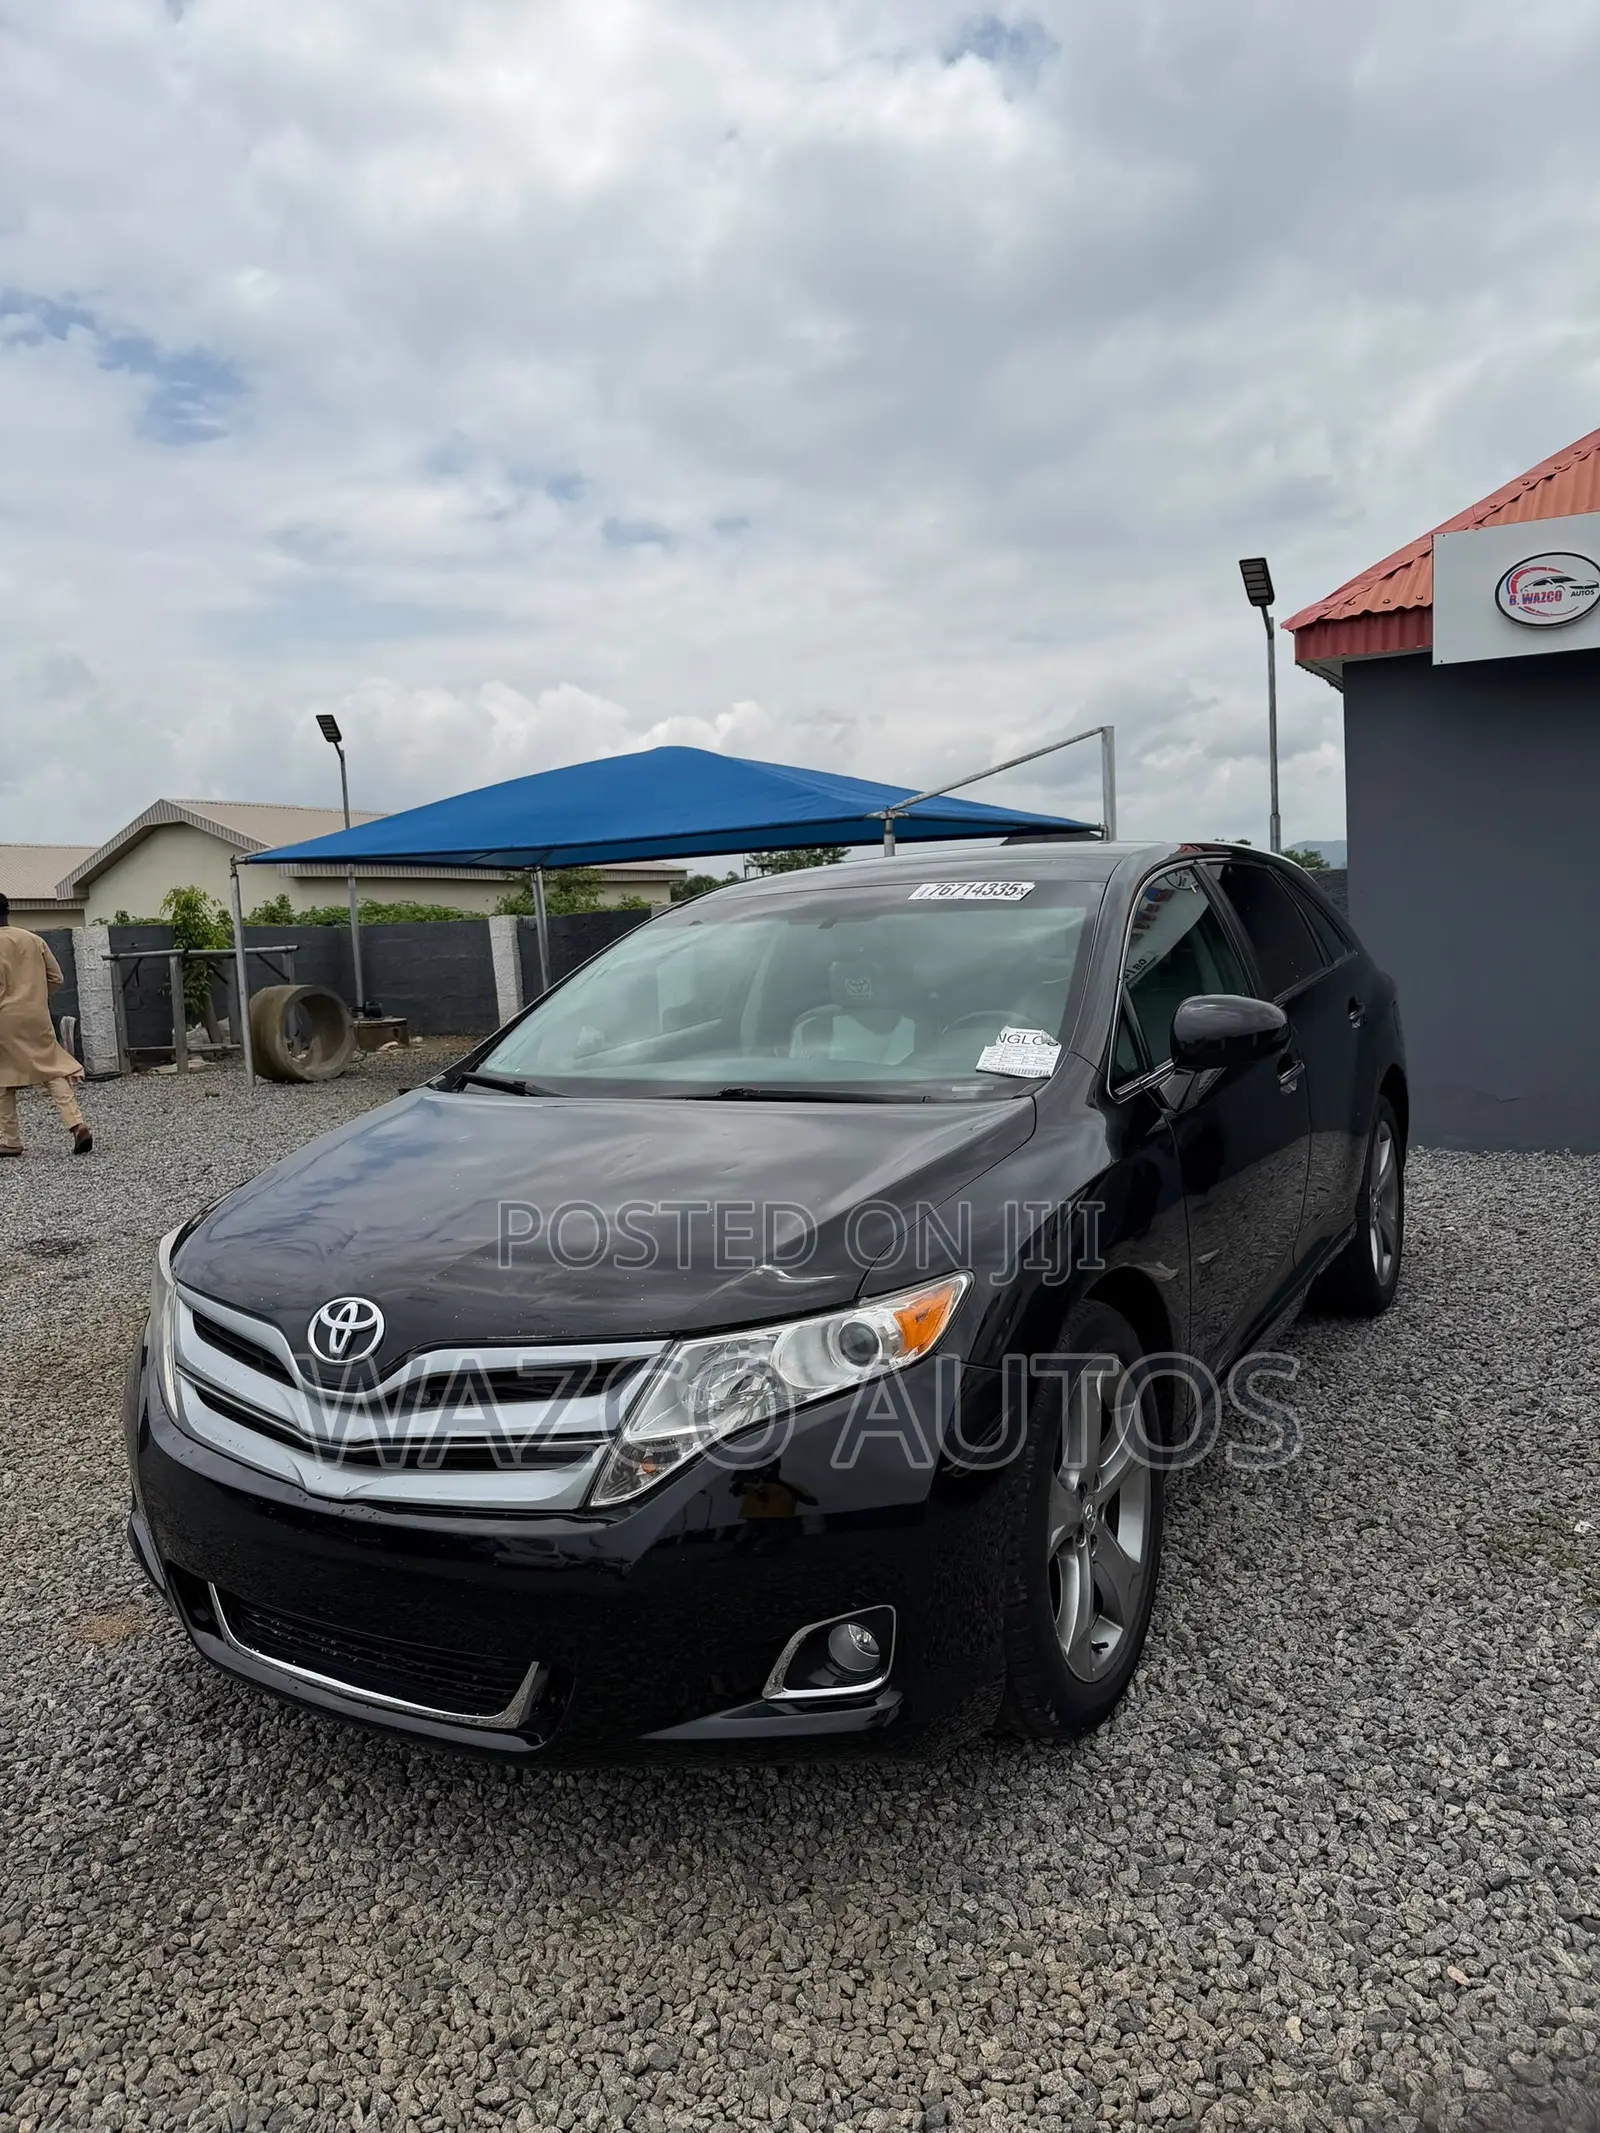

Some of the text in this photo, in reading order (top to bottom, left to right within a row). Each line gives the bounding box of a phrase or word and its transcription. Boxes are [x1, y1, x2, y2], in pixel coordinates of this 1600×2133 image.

[1509, 589, 1595, 606] B. WAZCO AUTOS
